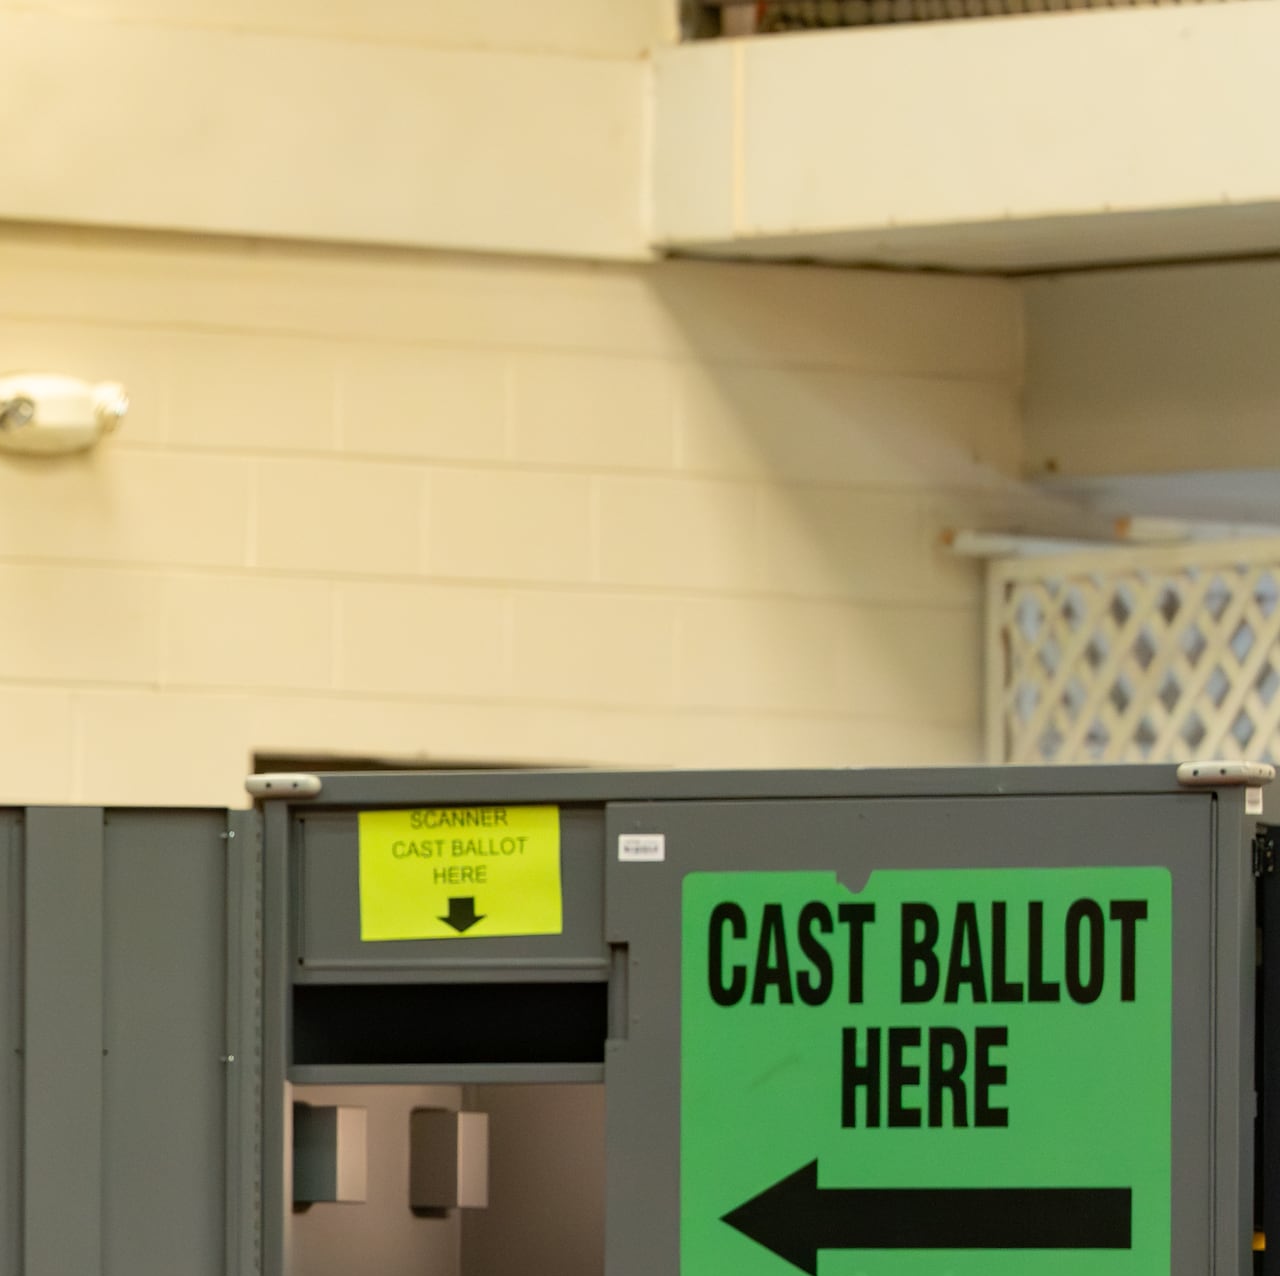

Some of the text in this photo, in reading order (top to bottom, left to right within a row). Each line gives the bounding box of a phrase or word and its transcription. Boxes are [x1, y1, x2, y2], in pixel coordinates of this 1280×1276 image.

[410, 808, 507, 829] SCANNER
[392, 837, 529, 859] CAST BALLOT
[433, 865, 487, 885] HERE
[708, 898, 1148, 1006] CAST BALLOT
[841, 1025, 1009, 1129] HERE
